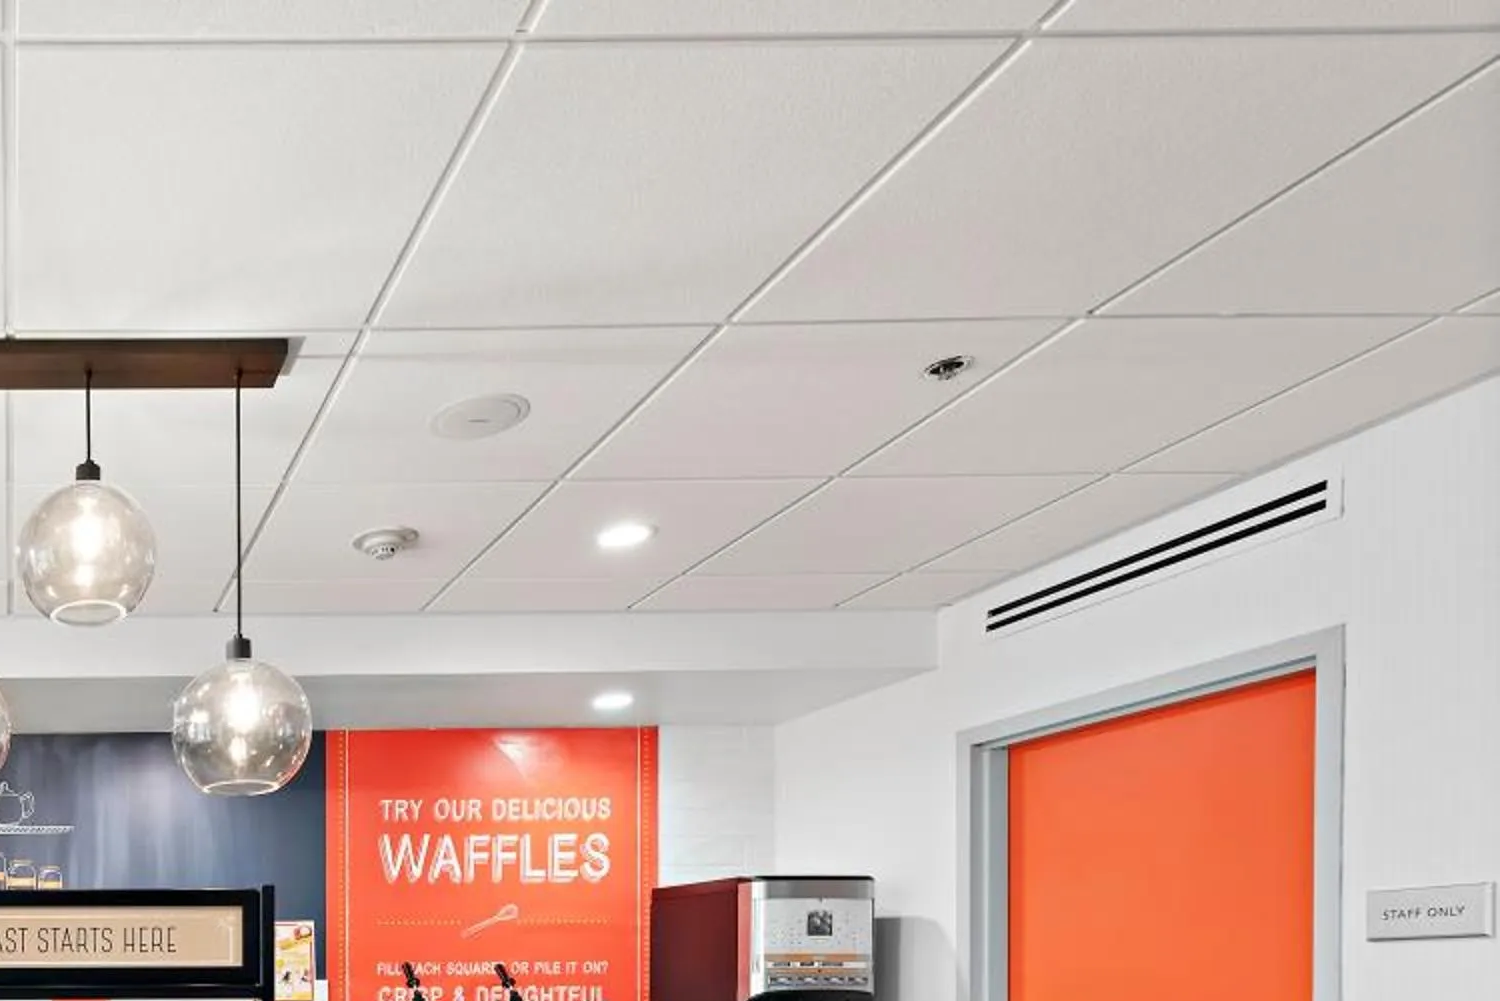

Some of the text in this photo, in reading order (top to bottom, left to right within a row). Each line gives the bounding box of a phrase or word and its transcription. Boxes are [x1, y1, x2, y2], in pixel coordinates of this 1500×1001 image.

[379, 797, 612, 823] TRY OUR DELICIOUS
[378, 832, 612, 885] WAFFLES
[1380, 904, 1465, 920] STAFF ONLY
[36, 926, 115, 954] STARTS
[122, 926, 178, 954] HERE
[409, 961, 441, 976] ACH
[510, 961, 529, 976] OR
[533, 961, 562, 976] PILE
[565, 961, 578, 975] IT
